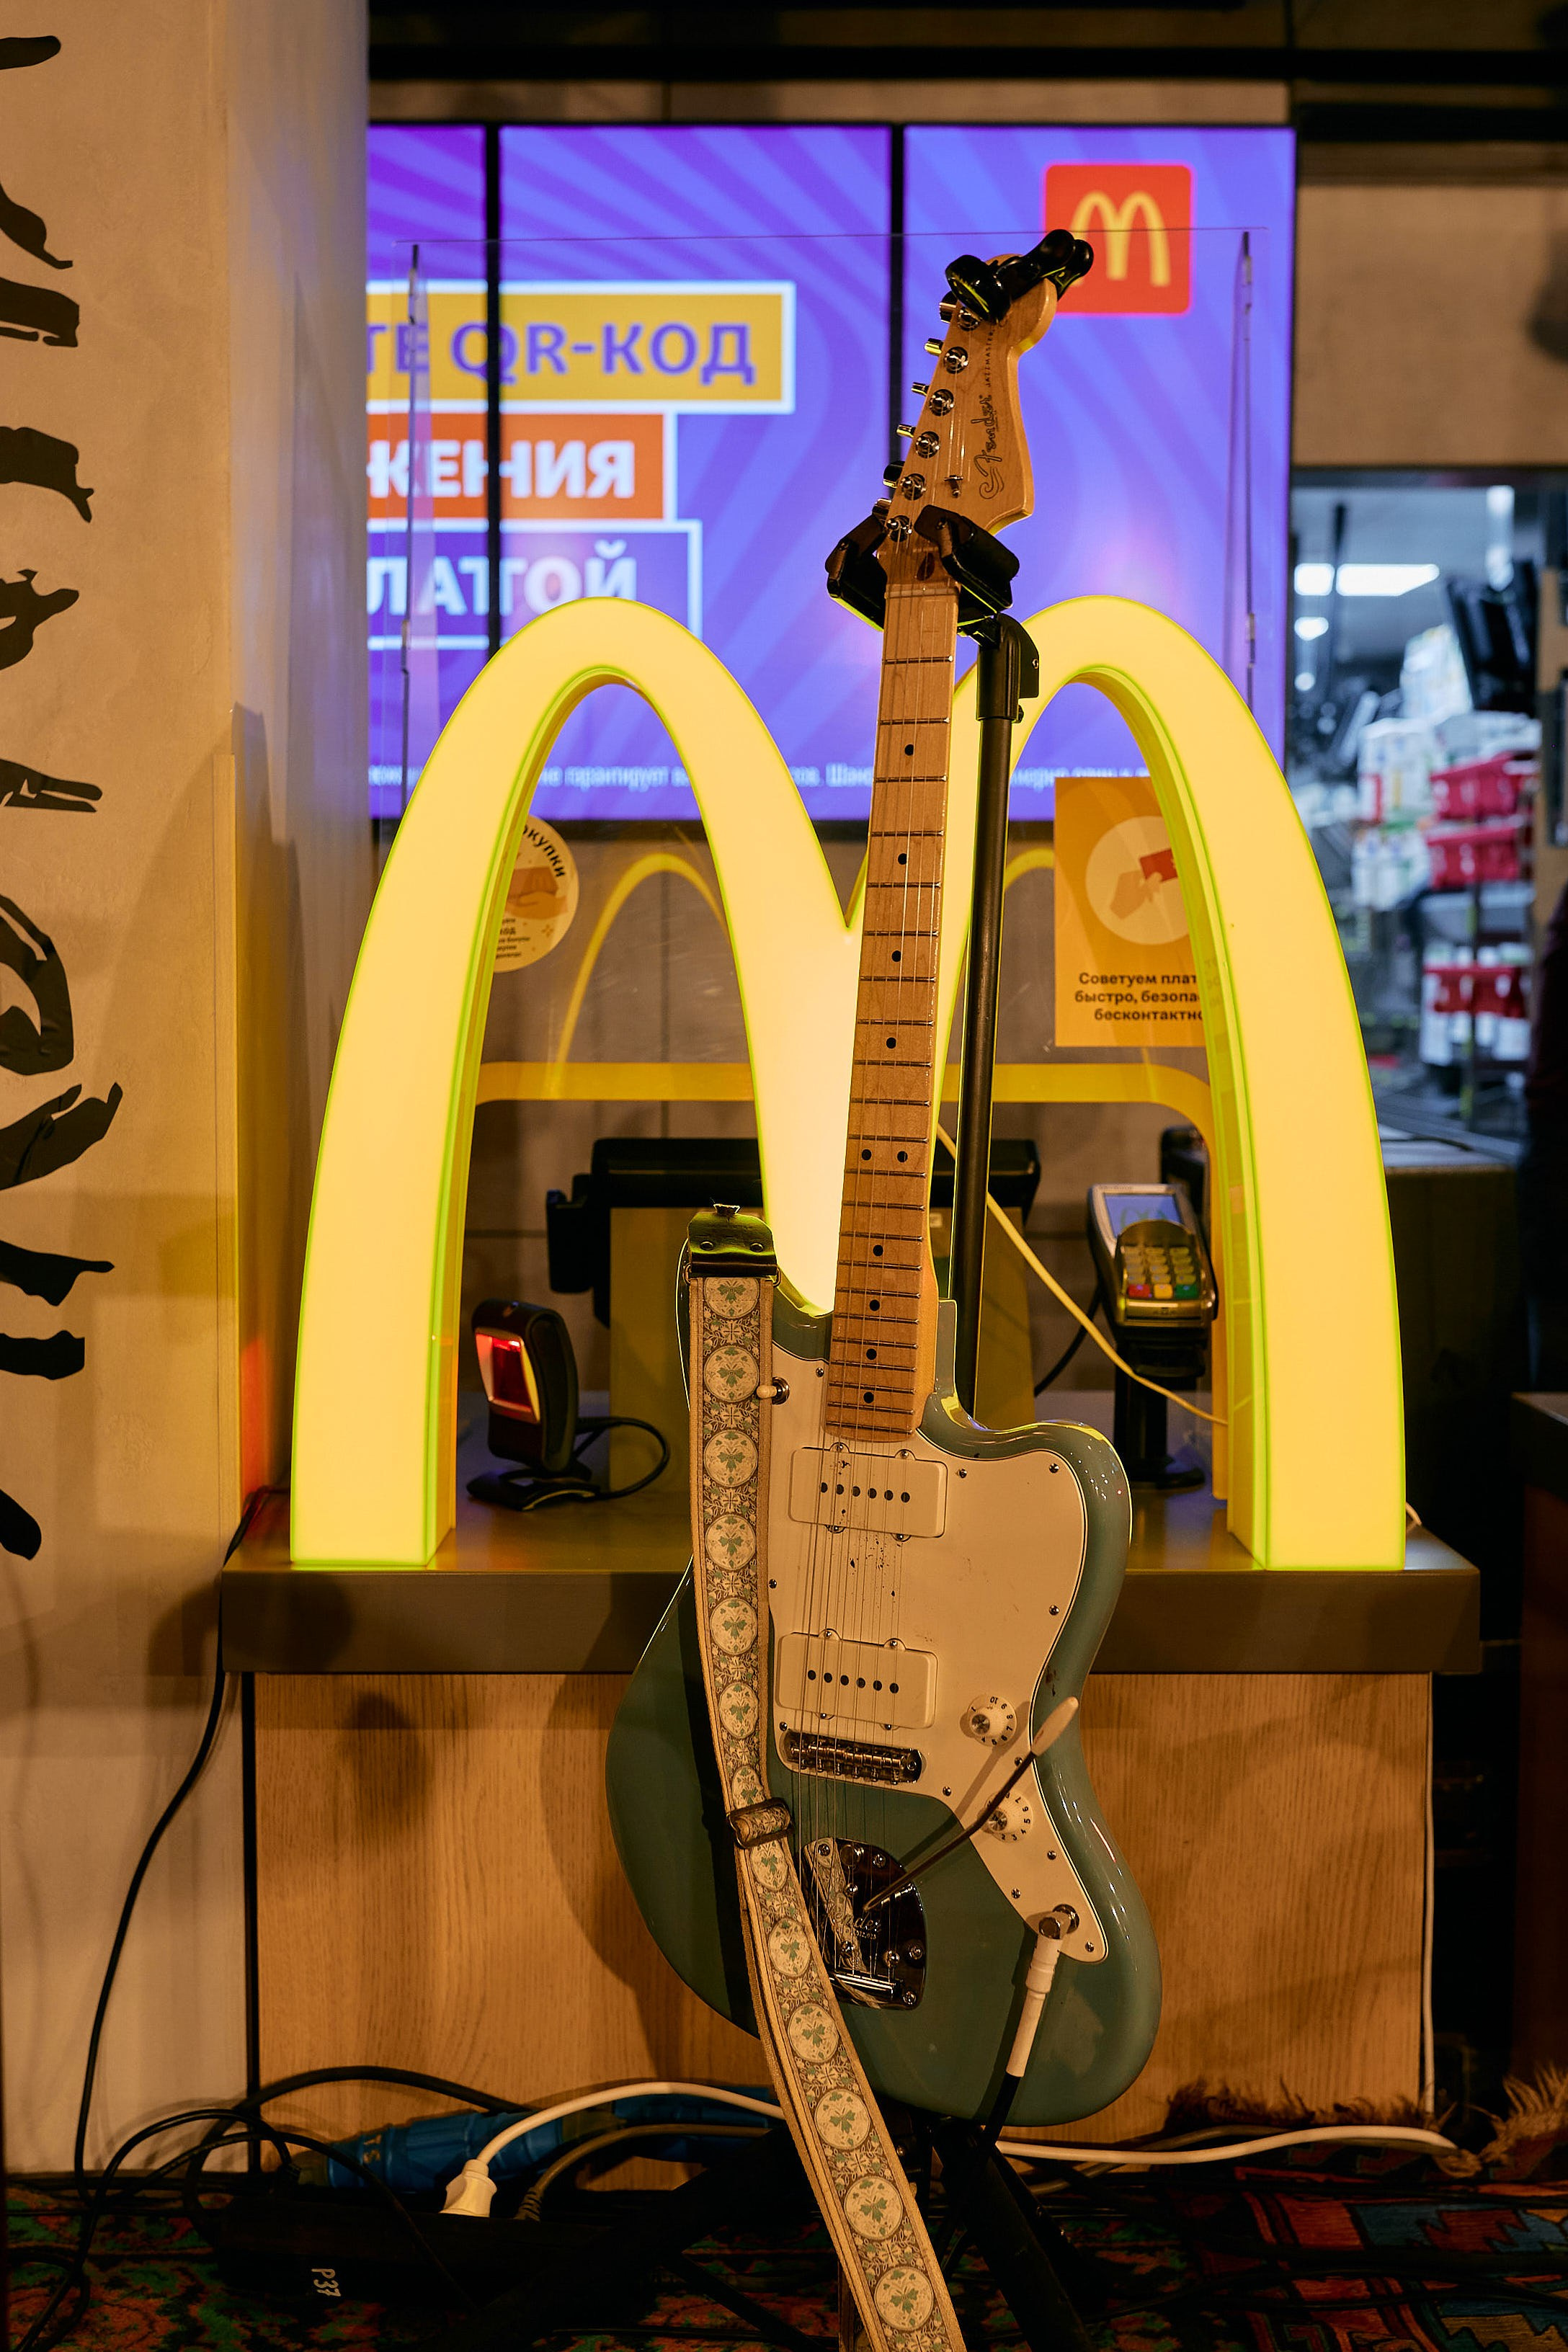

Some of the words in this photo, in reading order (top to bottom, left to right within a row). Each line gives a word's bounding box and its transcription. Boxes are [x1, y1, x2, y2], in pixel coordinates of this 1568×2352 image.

[448, 321, 757, 387] QR-КОД
[971, 395, 1004, 499] Fender
[366, 540, 638, 615] ЛАТОЙ
[1079, 972, 1157, 987] Советуем
[1074, 991, 1138, 1005] быстро,
[1141, 991, 1200, 1003] безопа
[989, 1696, 999, 1705] 10
[311, 2268, 342, 2297] P37
